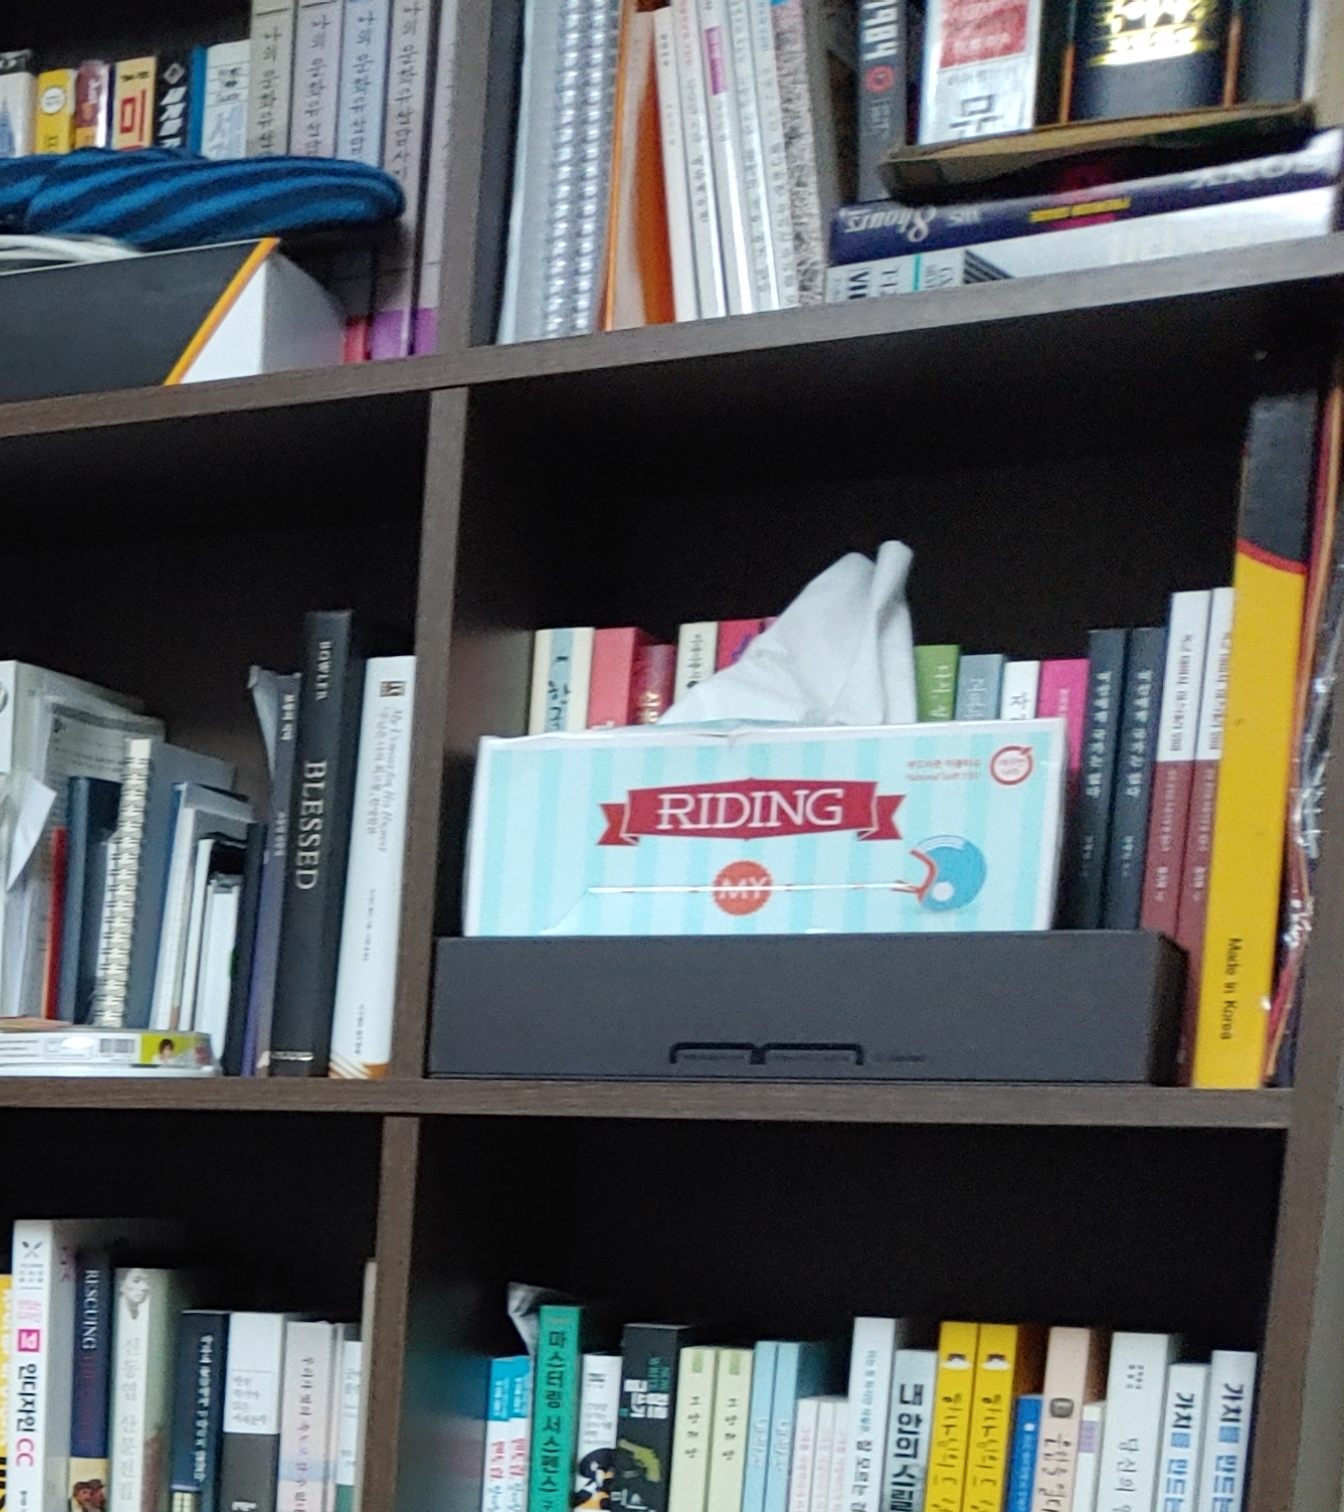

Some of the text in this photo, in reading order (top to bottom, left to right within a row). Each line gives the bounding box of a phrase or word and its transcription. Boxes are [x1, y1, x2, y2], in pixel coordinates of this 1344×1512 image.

[314, 640, 332, 700] BOWLER
[294, 760, 328, 891] BLESSED
[656, 787, 845, 830] RIDING
[717, 876, 769, 901] MY
[1218, 937, 1244, 1040] Made in Korea
[81, 1269, 101, 1350] RESCUING
[14, 1363, 39, 1467] 인디자인 CC
[899, 1383, 925, 1406] 내
[1170, 1391, 1195, 1449] 가치를
[1218, 1382, 1244, 1444] 가치를
[856, 1439, 874, 1453] 잘
[1114, 1437, 1139, 1493] 당신의
[852, 1455, 872, 1497] 모르는
